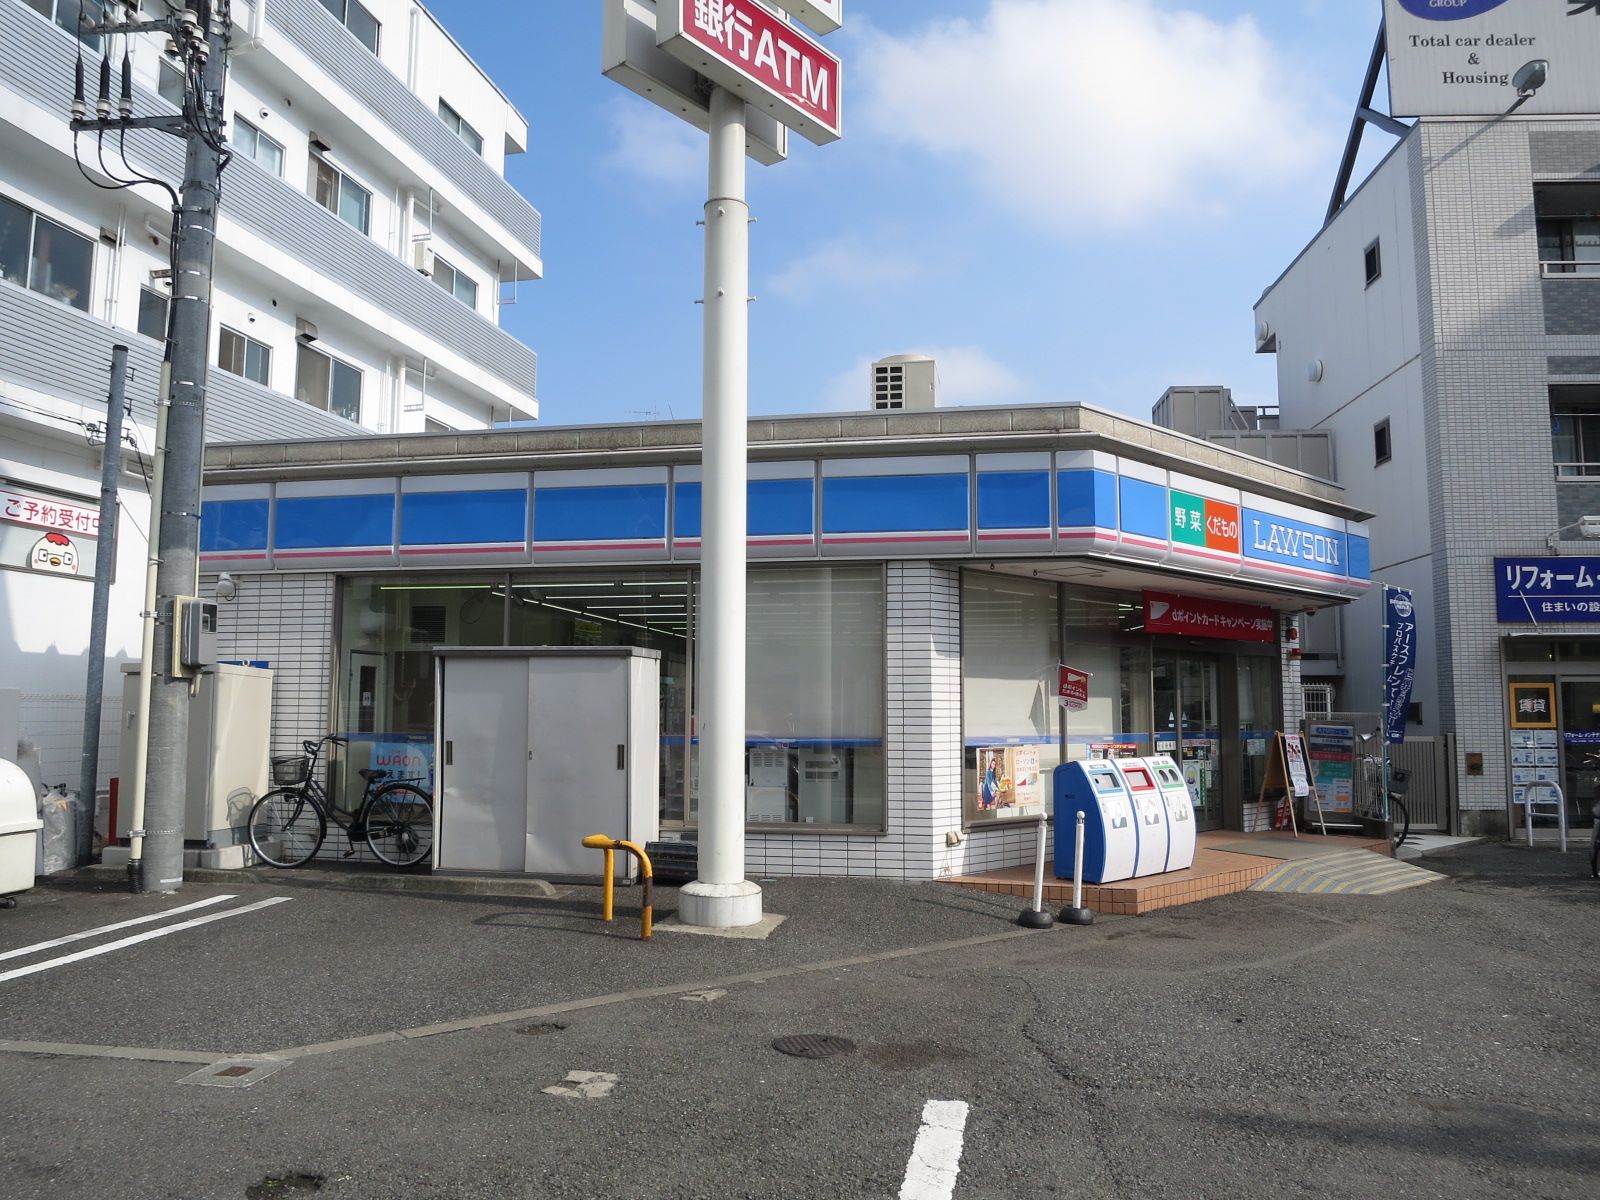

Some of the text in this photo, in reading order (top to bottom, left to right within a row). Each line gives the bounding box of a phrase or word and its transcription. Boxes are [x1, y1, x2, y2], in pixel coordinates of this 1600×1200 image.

[1429, 0, 1467, 8] GROUP
[1409, 33, 1536, 47] Total car dealer
[694, 0, 828, 112] 銀行ATM
[1467, 53, 1480, 65] &
[1442, 71, 1509, 86] Housing
[1174, 506, 1238, 540] 野菜 くだもの
[1252, 519, 1340, 565] LAWSON
[1541, 601, 1600, 612] 住まいの設
[1171, 608, 1273, 631] dポイントカードキャンペーン実施中
[1518, 698, 1546, 713] 賃貸
